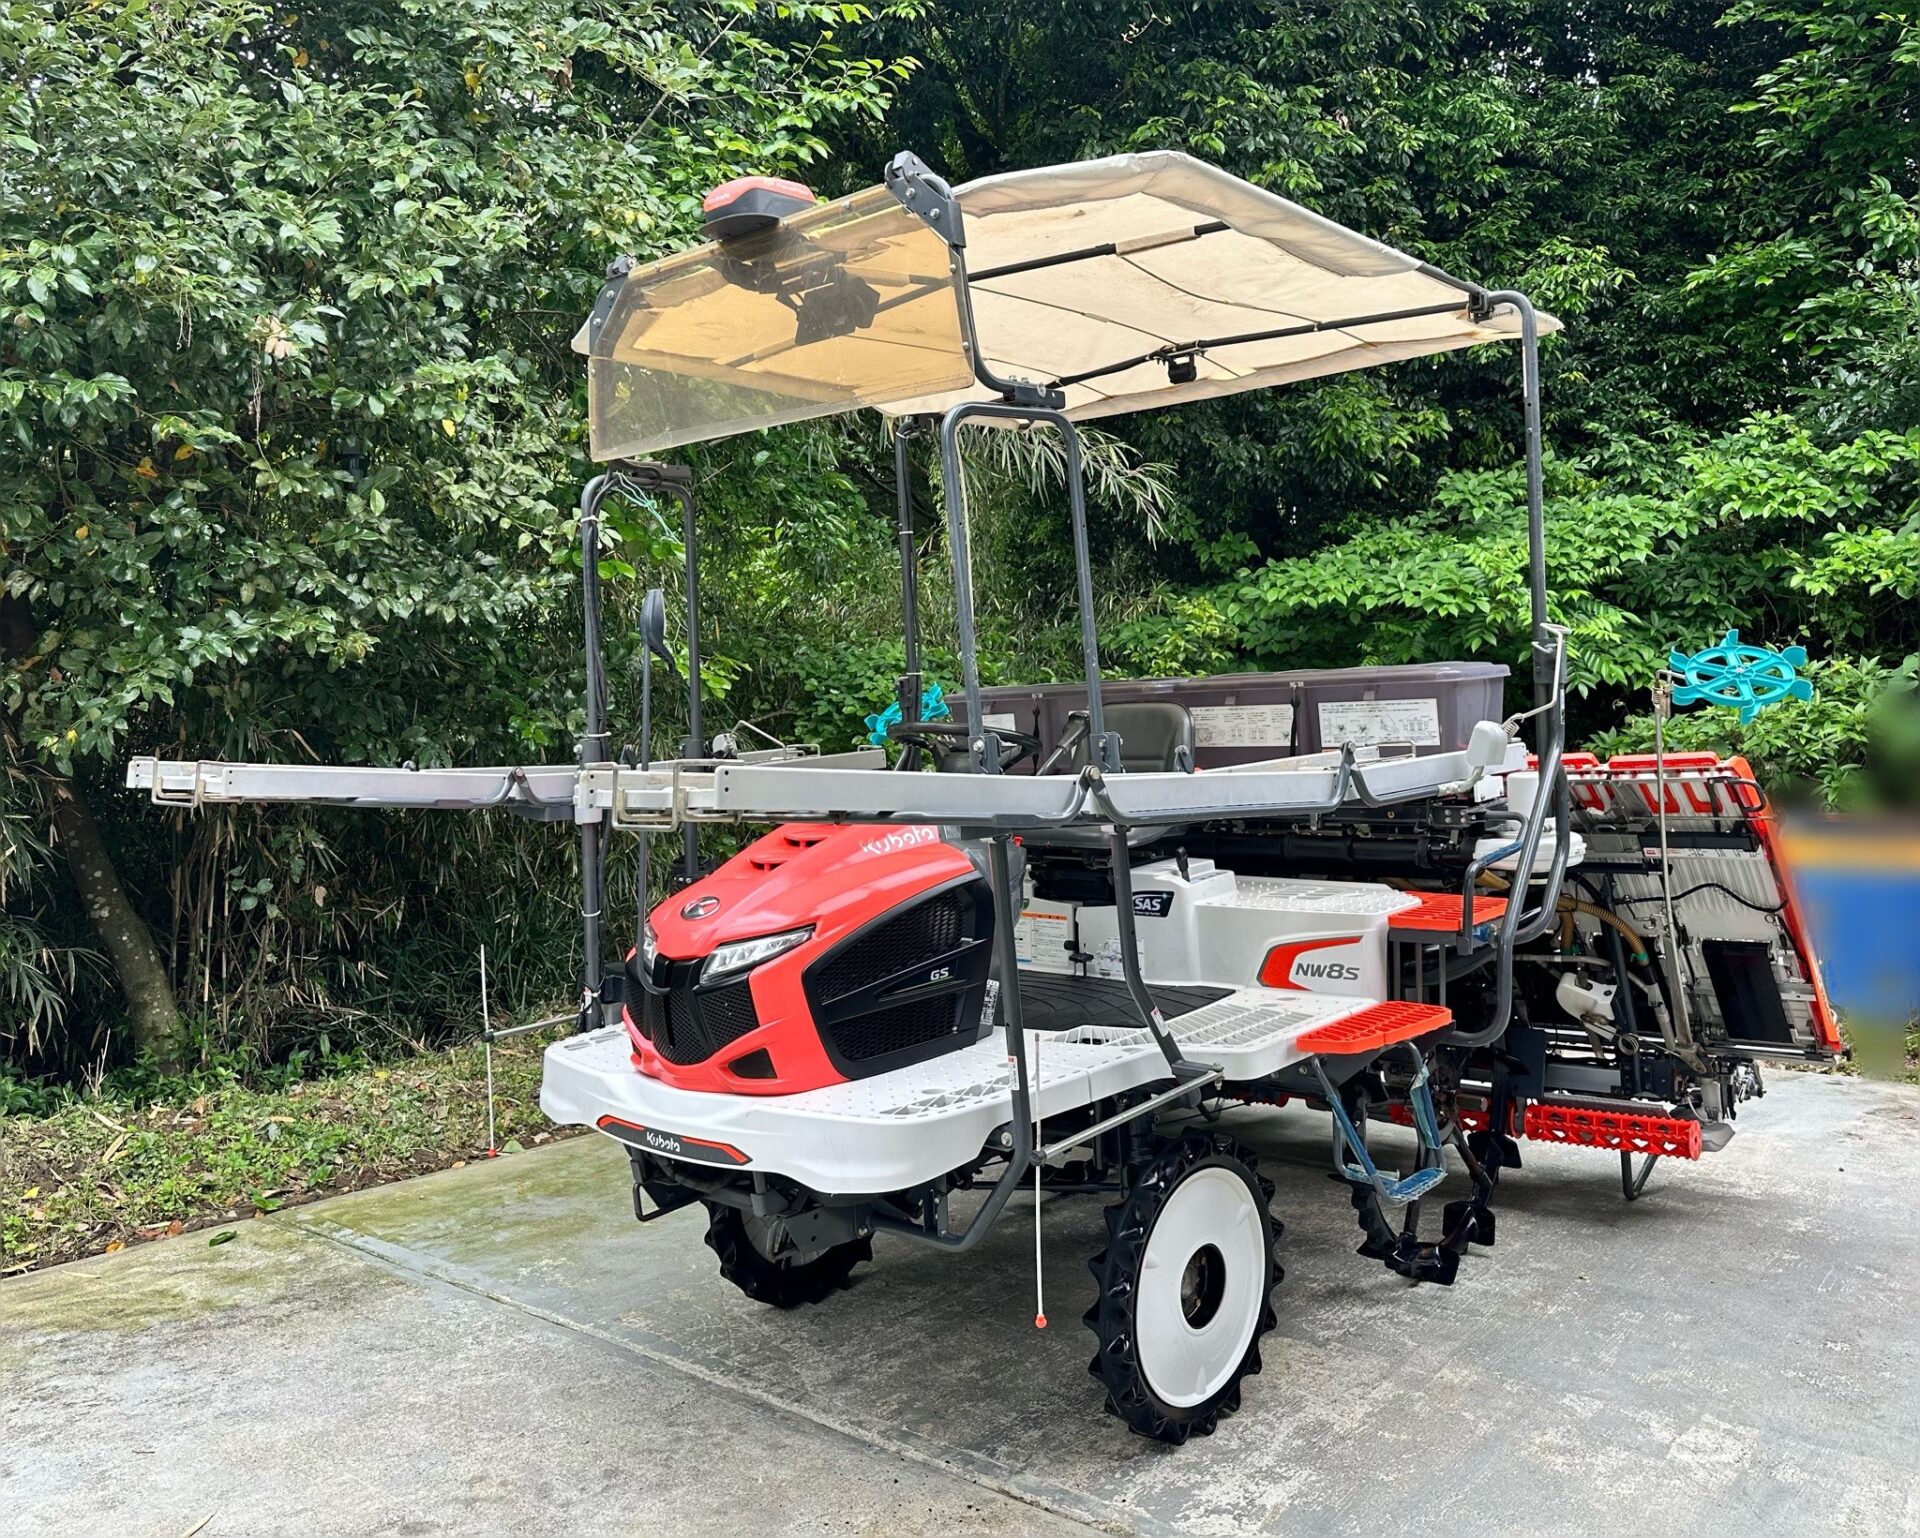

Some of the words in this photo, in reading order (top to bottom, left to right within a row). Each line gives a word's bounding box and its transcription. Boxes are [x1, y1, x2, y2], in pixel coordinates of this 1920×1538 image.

[859, 825, 936, 855] Kubota
[930, 966, 949, 981] GS
[1295, 962, 1360, 981] NW8S
[646, 1131, 681, 1152] Kubota
